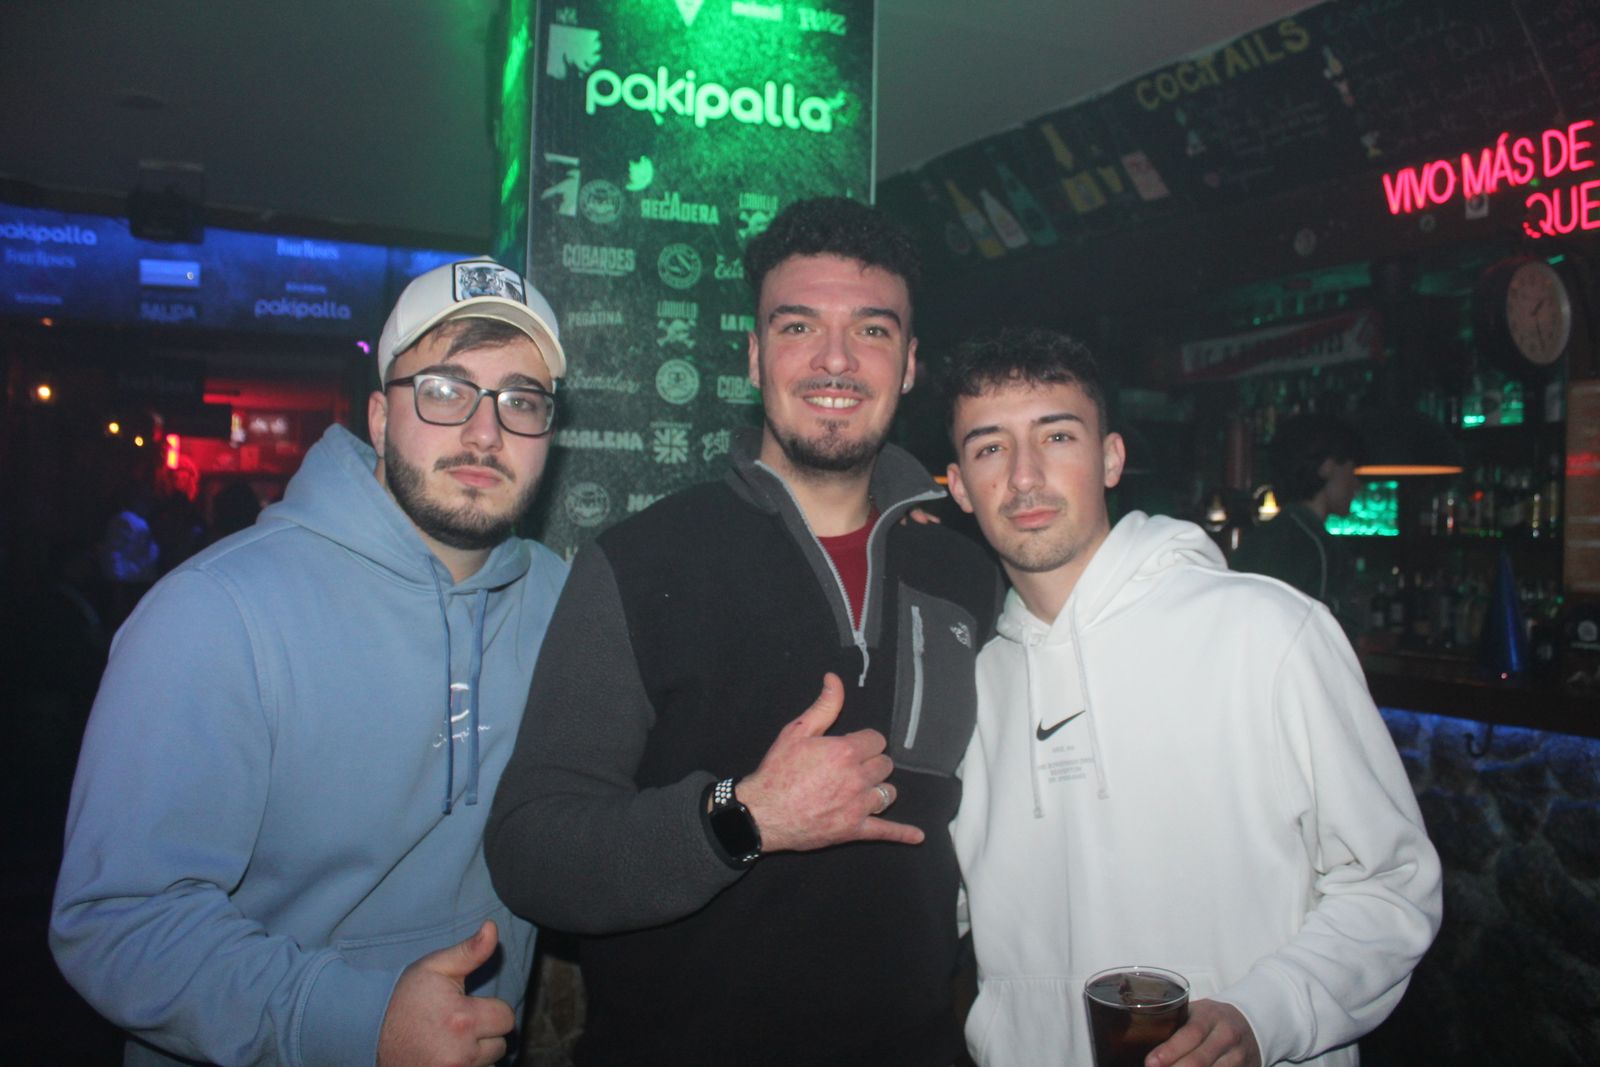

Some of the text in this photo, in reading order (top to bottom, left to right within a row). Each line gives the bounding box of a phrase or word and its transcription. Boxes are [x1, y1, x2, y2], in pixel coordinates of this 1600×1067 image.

[586, 66, 832, 132] pakipalla
[1383, 120, 1595, 215] VIVO MÁS DE
[1522, 180, 1600, 239] QUE
[254, 298, 352, 320] pakipalla
